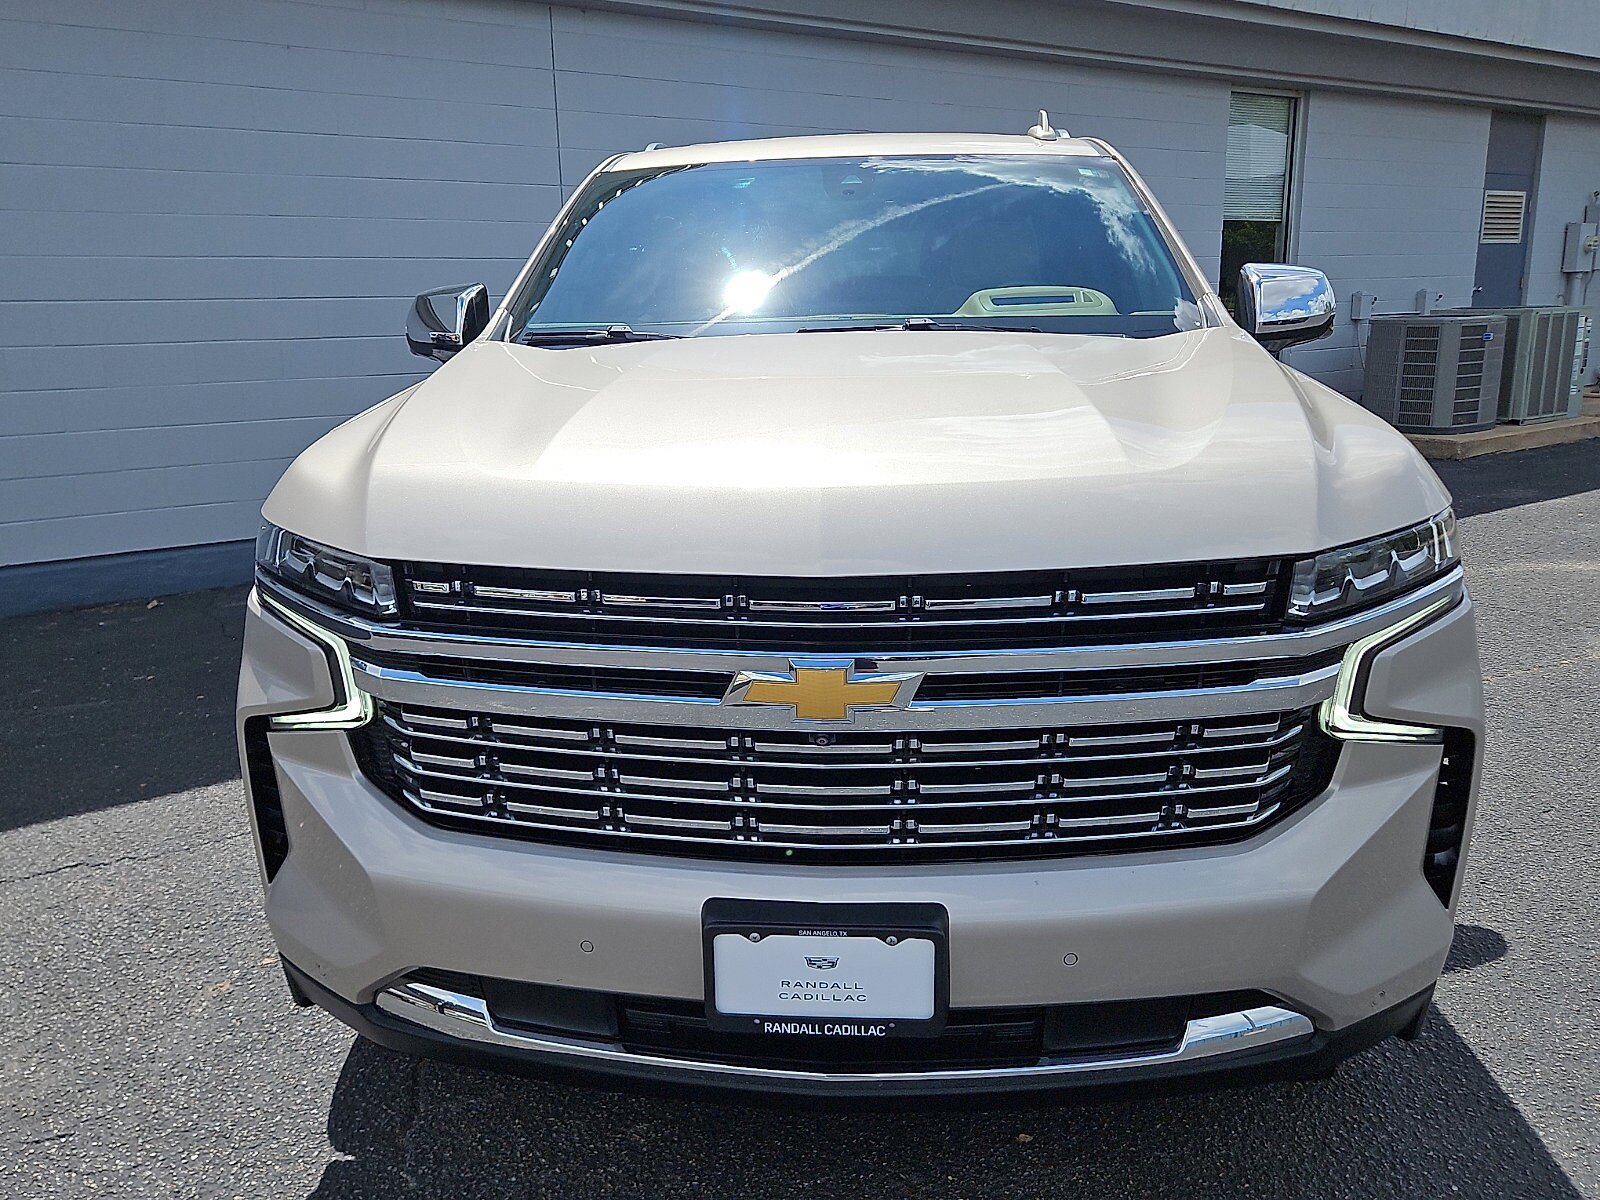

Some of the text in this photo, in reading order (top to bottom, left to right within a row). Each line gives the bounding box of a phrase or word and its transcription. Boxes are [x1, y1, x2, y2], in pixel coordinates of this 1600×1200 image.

[781, 980, 864, 990] RANDALL
[778, 992, 867, 1002] CADILLAC
[764, 1022, 886, 1037] RANDALL CADILLAC
